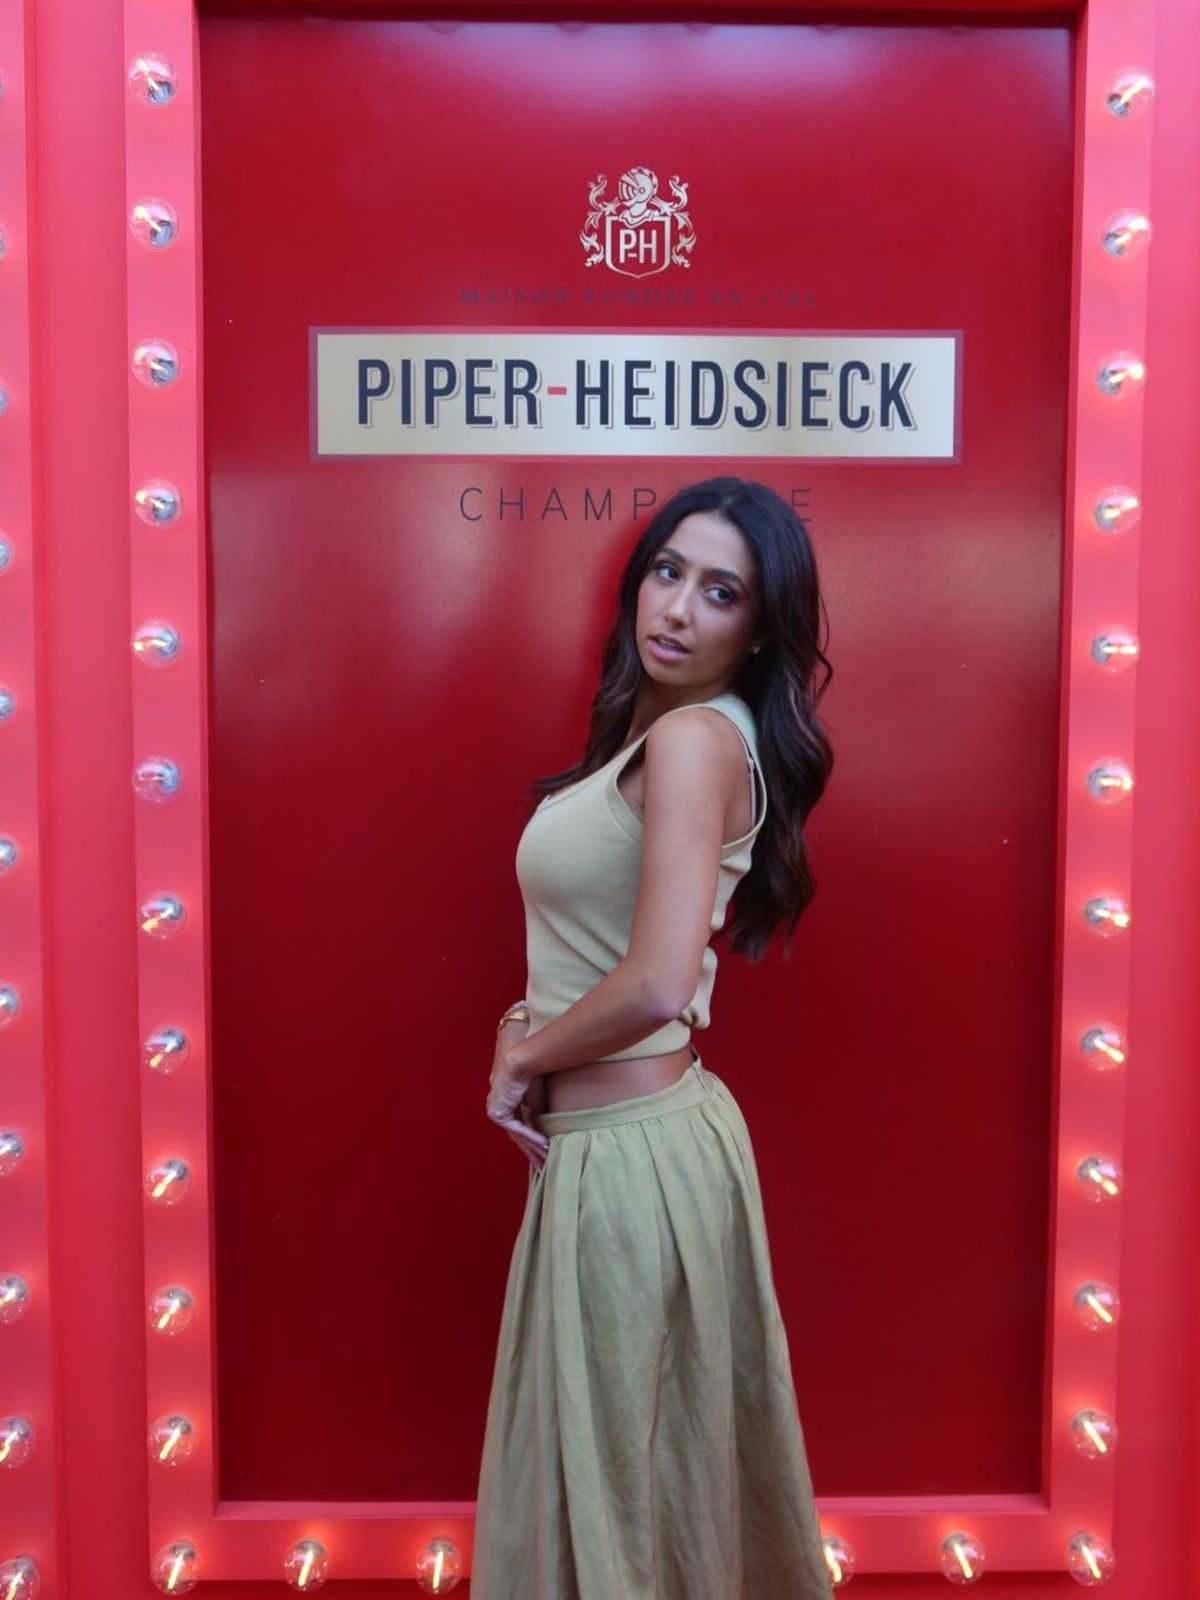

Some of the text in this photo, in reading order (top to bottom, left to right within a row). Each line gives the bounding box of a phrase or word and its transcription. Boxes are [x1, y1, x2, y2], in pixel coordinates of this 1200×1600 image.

[461, 287, 570, 305] MAISON
[358, 358, 918, 430] PIPER-HEIDSIECK
[461, 488, 813, 521] CHAMPE
